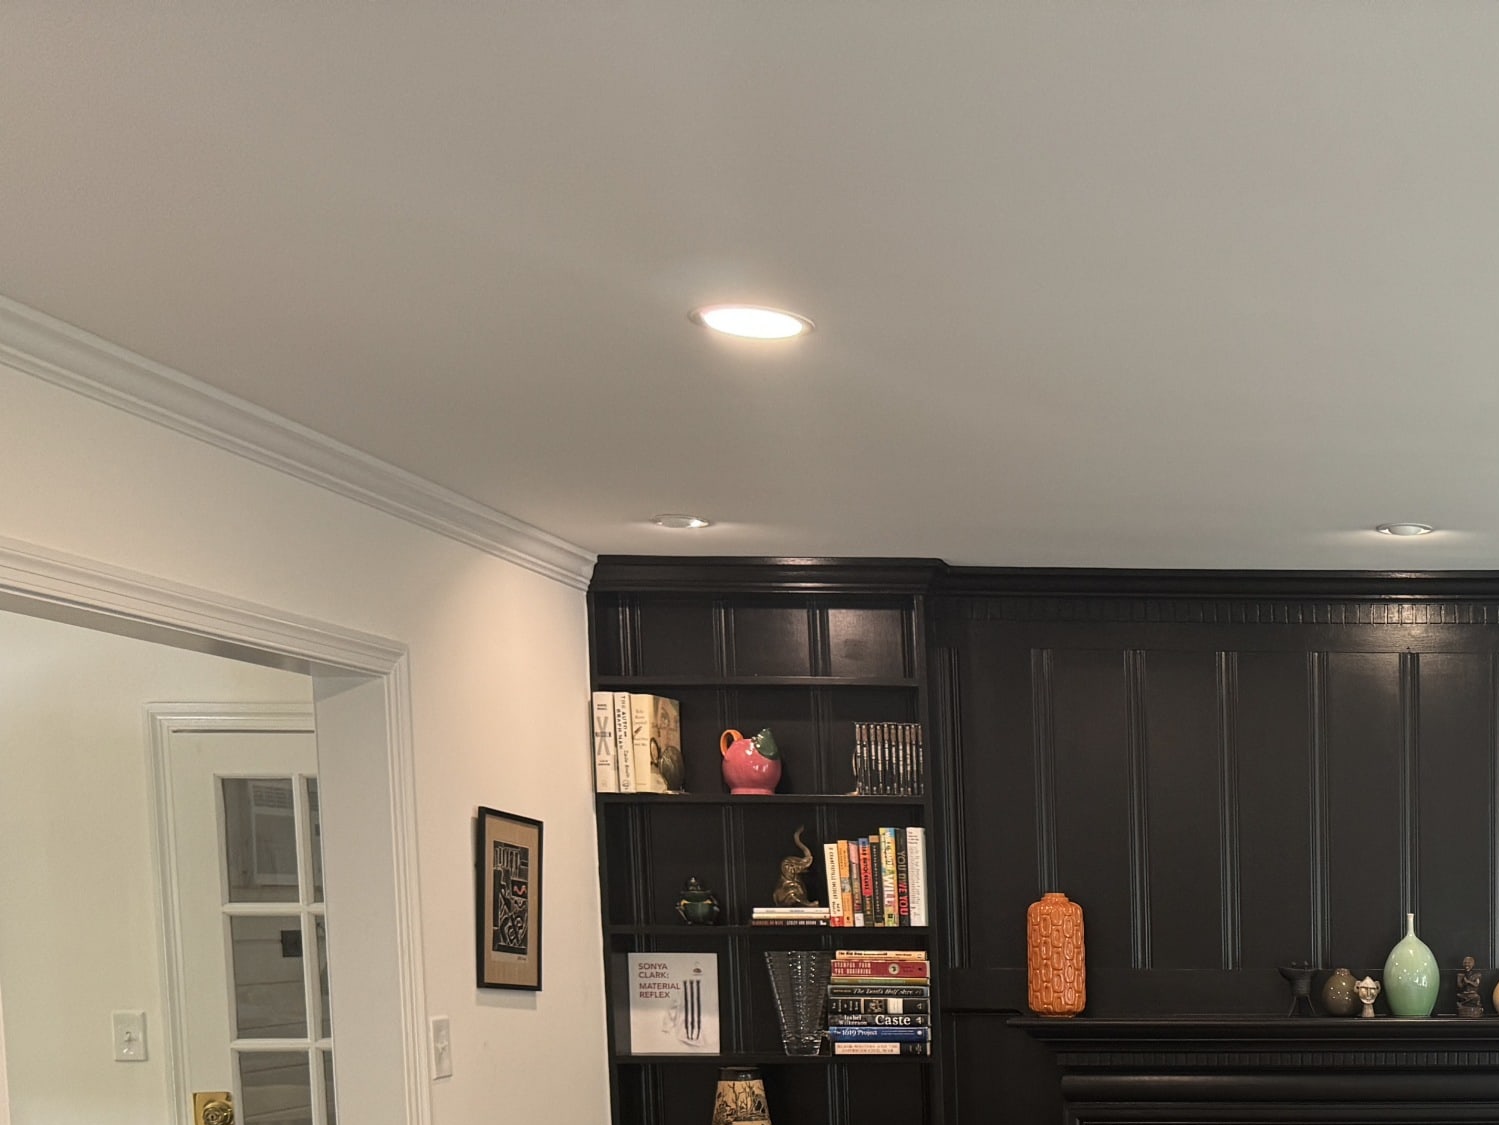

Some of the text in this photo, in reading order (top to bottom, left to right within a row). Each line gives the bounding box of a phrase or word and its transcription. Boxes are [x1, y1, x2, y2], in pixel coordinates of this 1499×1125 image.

[897, 851, 906, 871] YOU
[899, 896, 909, 916] YOU
[638, 962, 668, 970] SONYA
[638, 971, 669, 979] CLARK:
[639, 982, 681, 990] MATERIAL
[875, 1014, 911, 1026] Caste
